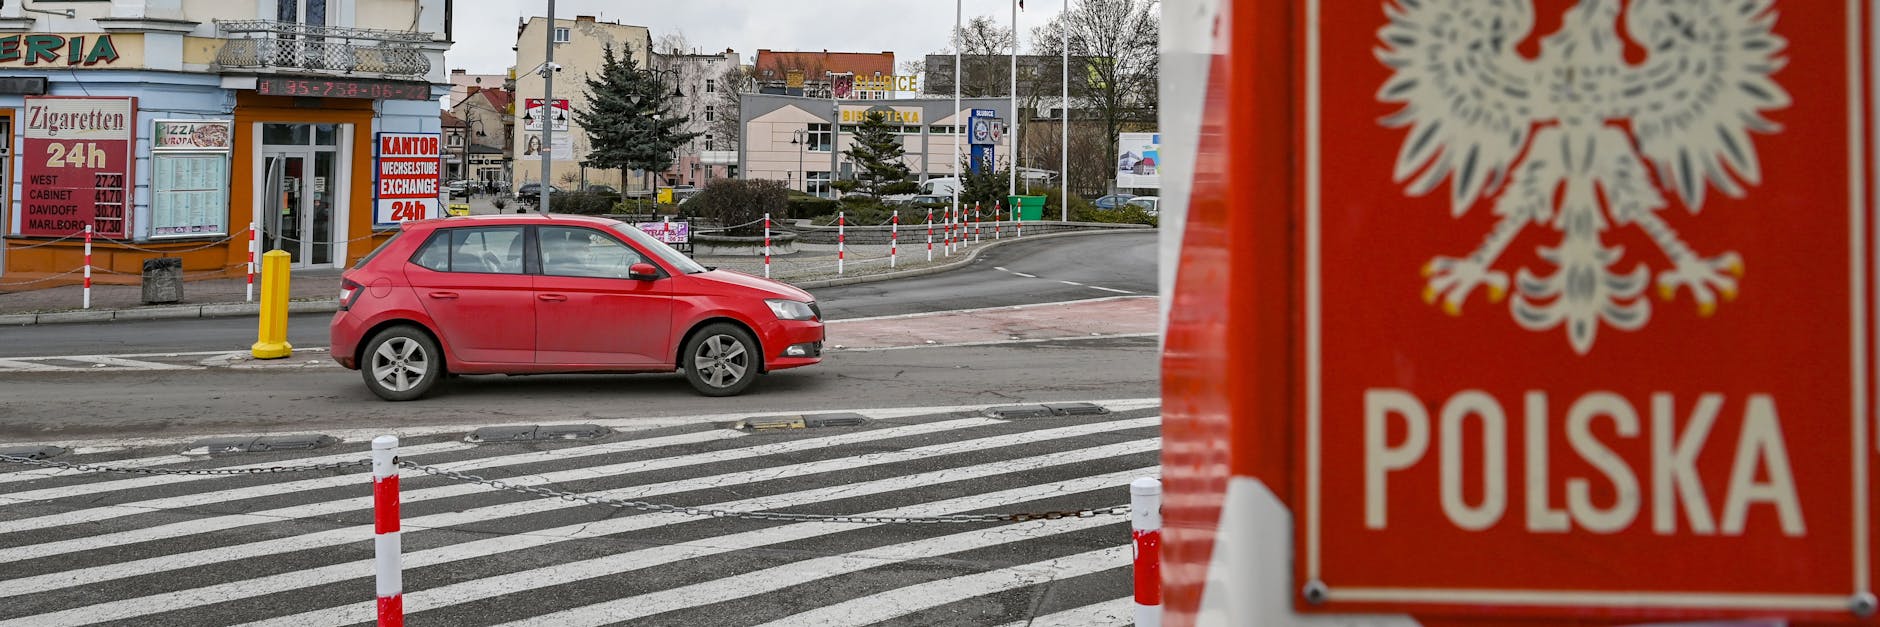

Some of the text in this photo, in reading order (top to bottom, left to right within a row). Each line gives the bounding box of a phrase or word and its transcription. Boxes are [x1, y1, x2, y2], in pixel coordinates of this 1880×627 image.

[29, 105, 124, 136] Zigaretten
[159, 124, 195, 135] PIZZA
[382, 136, 438, 155] KANTOR
[46, 142, 106, 169] 24h
[381, 161, 438, 175] WECHSELSTUBE
[30, 174, 122, 188] WEST 27.20
[381, 178, 437, 195] EXCHANGE
[29, 190, 73, 201] CABINET
[29, 205, 78, 215] DAVIDOFF
[391, 201, 426, 221] 24h
[29, 219, 86, 230] MARLBORO
[1364, 389, 1807, 537] POLSKA
